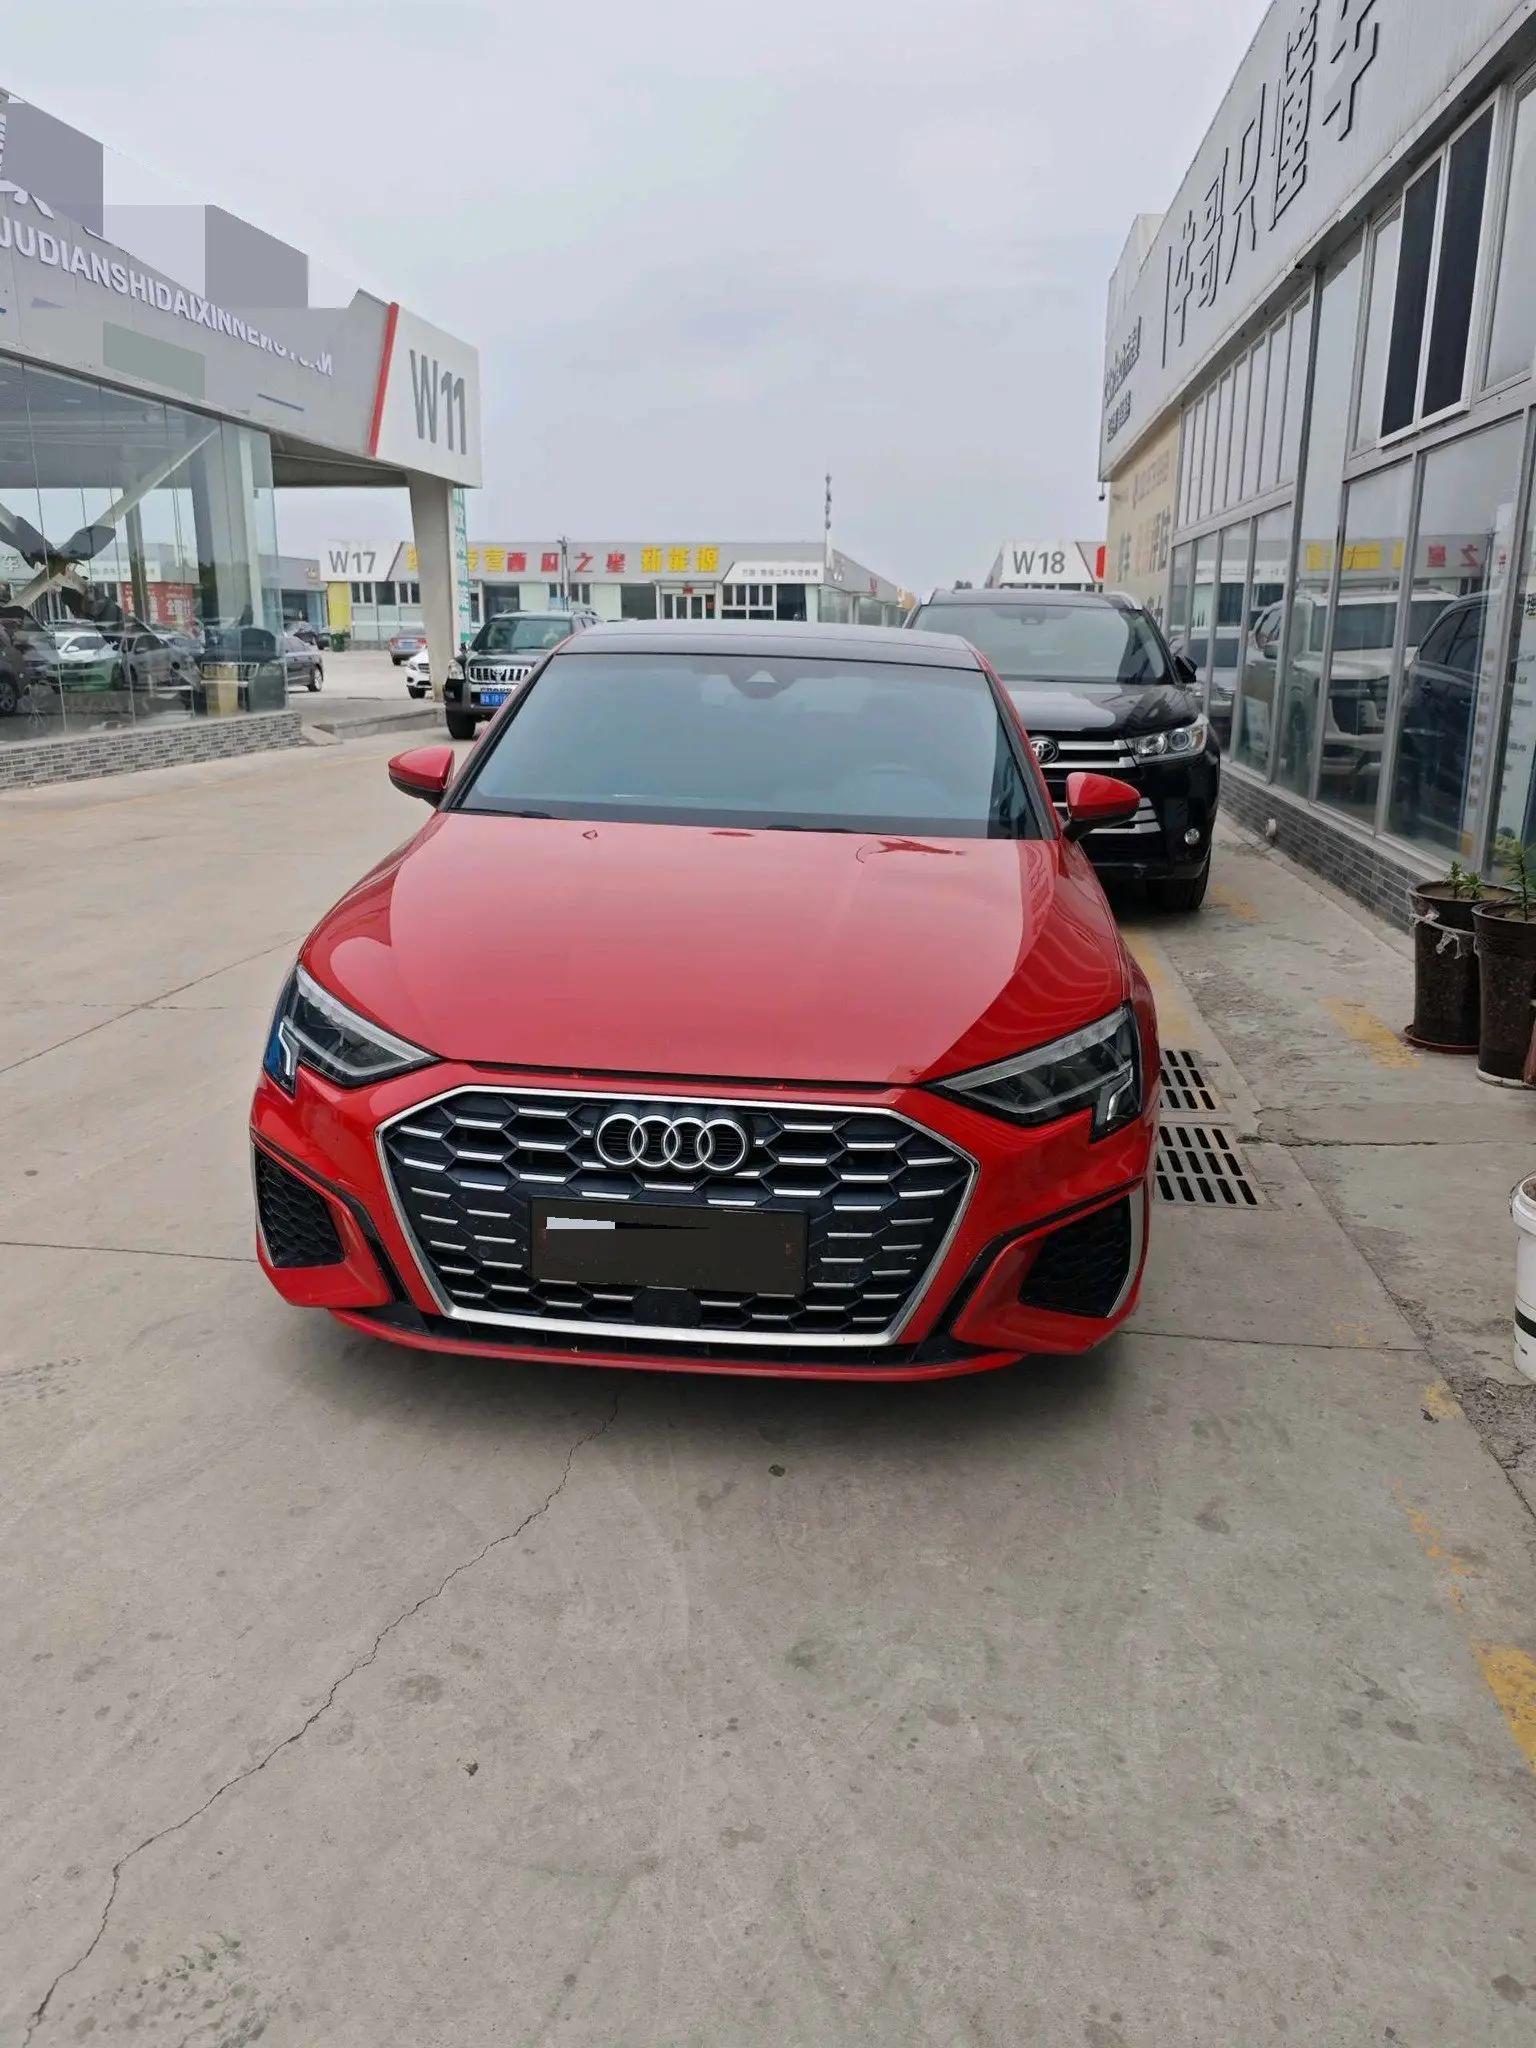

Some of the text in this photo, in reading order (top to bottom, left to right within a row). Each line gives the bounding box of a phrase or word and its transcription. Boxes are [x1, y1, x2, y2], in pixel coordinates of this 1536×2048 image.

[408, 349, 468, 455] W11
[328, 550, 376, 574] W17
[1013, 551, 1066, 575] W18
